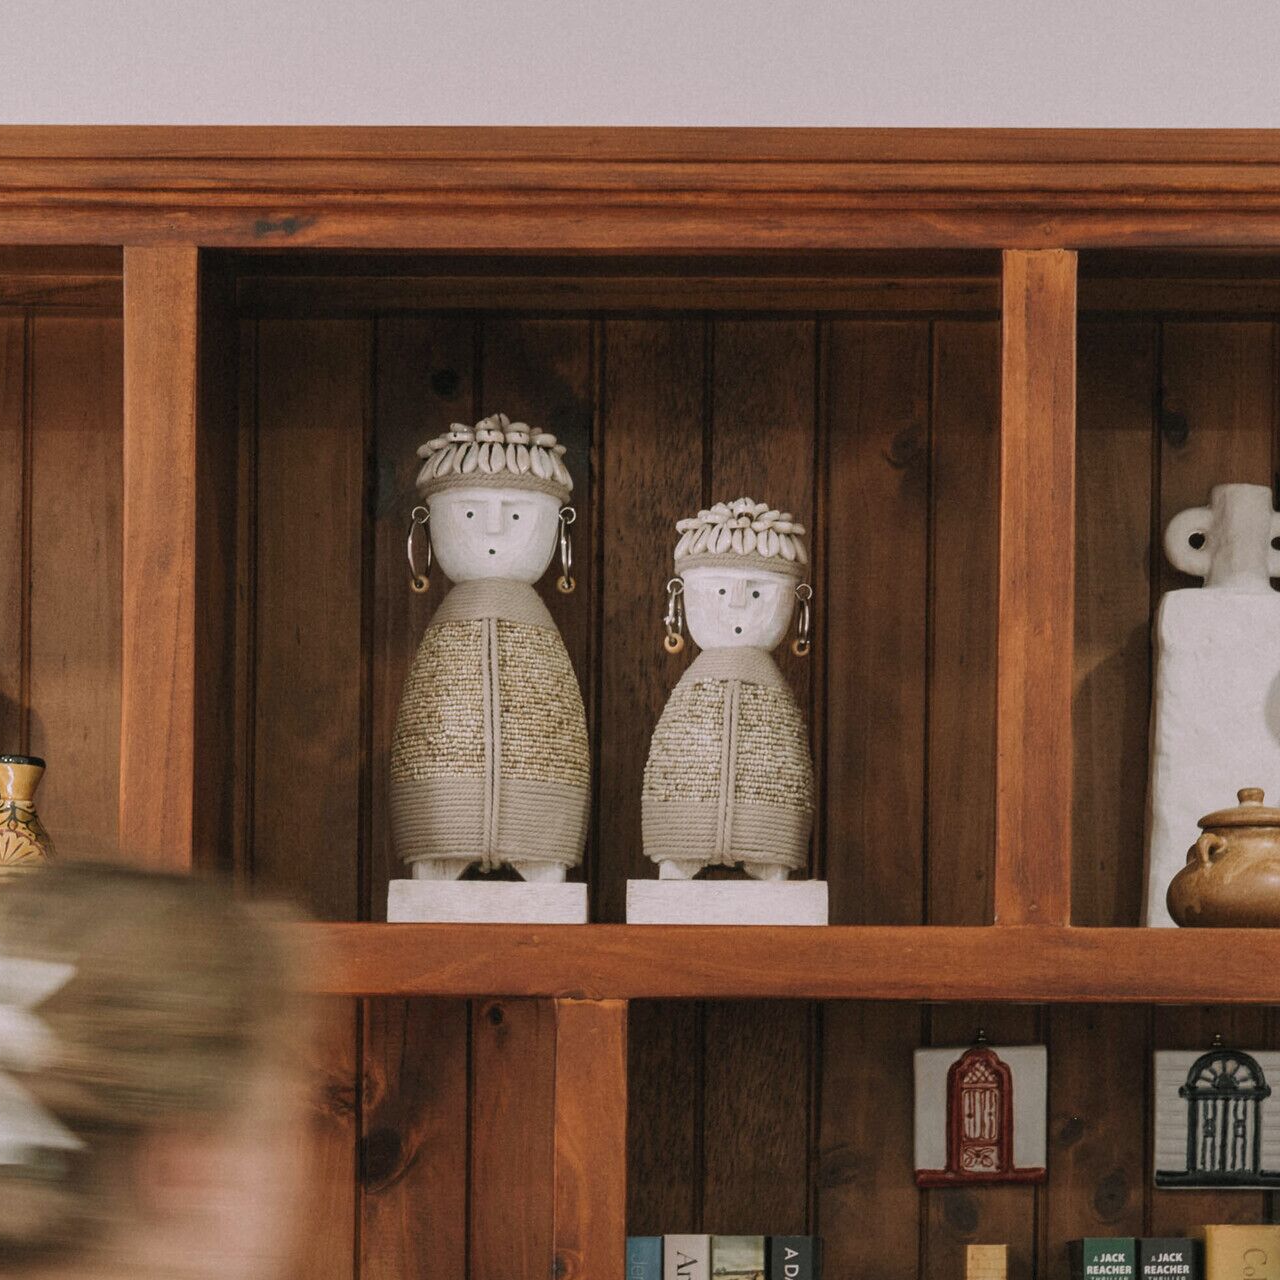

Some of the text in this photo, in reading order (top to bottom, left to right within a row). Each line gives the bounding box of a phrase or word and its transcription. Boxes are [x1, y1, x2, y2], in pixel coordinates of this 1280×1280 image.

[784, 1247, 799, 1260] A
[1099, 1253, 1125, 1262] JACK
[1157, 1253, 1183, 1262] JACK
[1086, 1265, 1132, 1275] REACHER
[1144, 1265, 1190, 1275] REACHER
